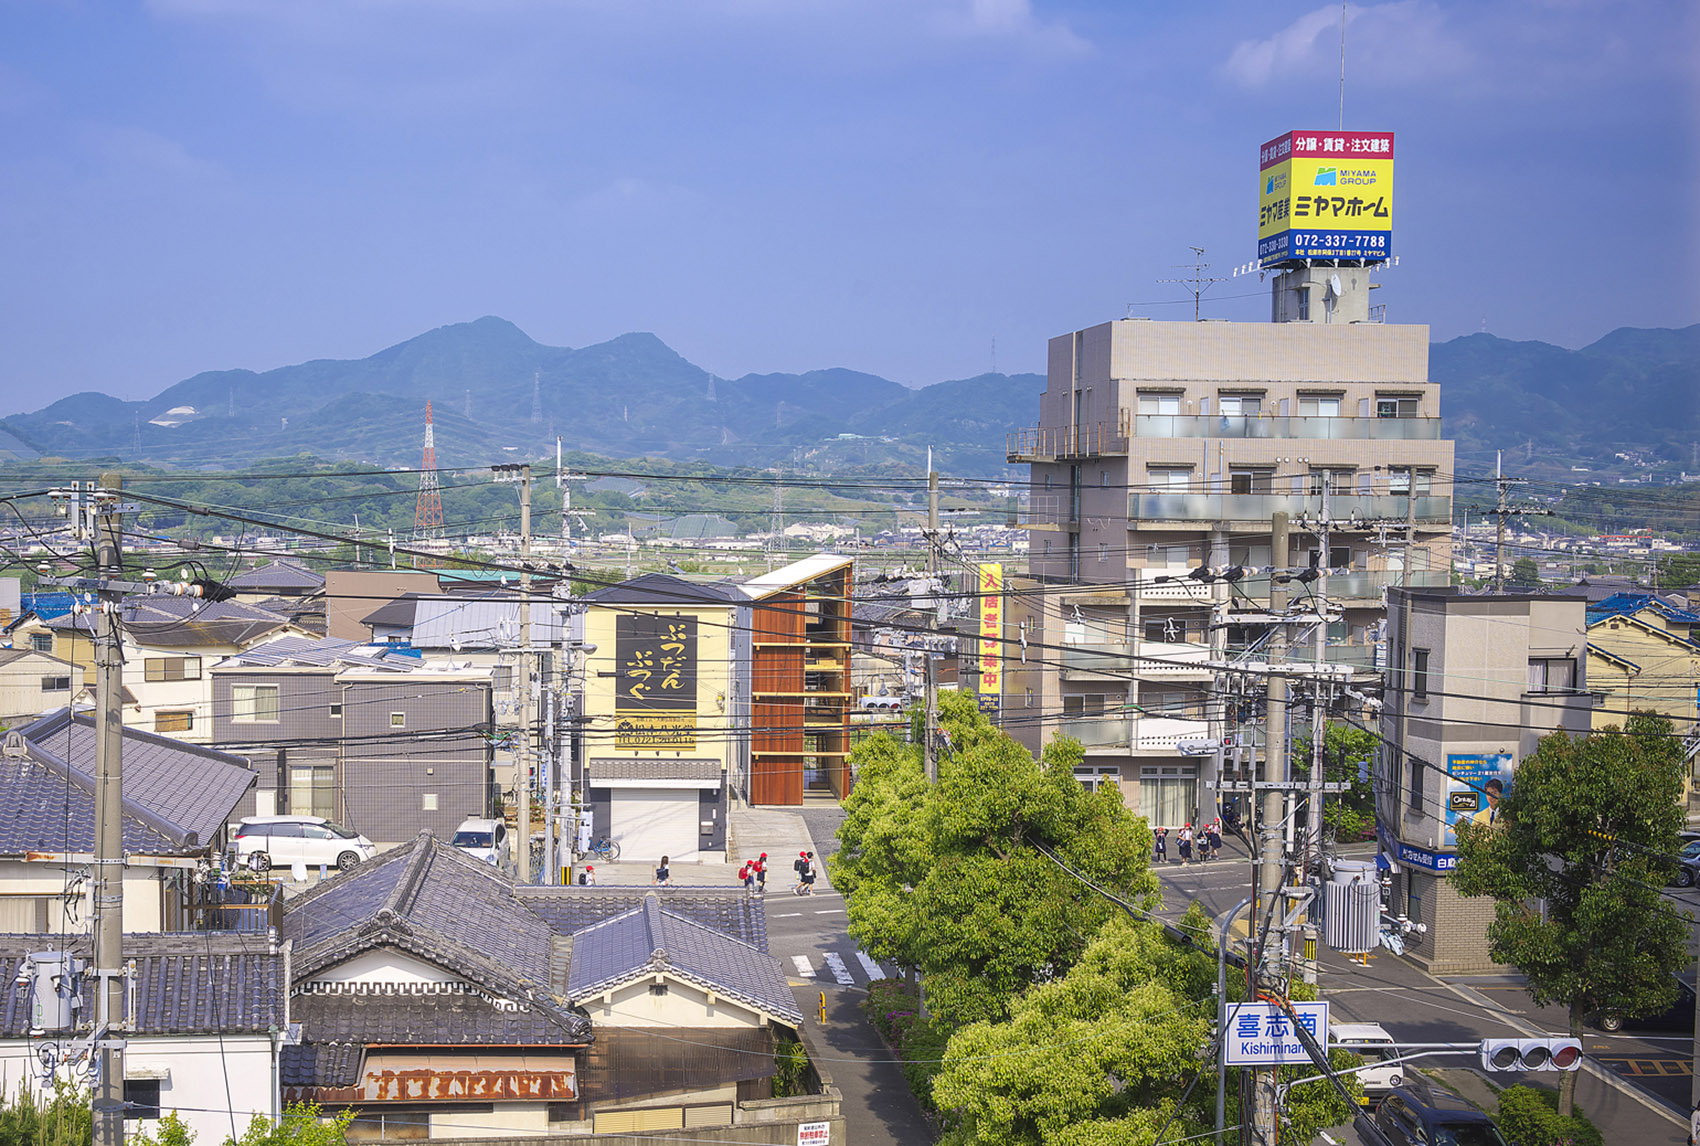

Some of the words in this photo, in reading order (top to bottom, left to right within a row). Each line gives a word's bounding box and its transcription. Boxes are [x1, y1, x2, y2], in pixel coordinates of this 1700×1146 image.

[1296, 137, 1390, 153] 分譲・賃貸・注文建築
[1260, 197, 1290, 227] ミヤマ産業
[1295, 196, 1388, 217] ミヤマホーム
[1295, 234, 1385, 247] 072-337-7788
[983, 573, 999, 687] 入居者募集中
[660, 624, 687, 689] ぶつだん
[627, 651, 653, 700] ぶつぐ
[1236, 1012, 1317, 1038] 喜志南
